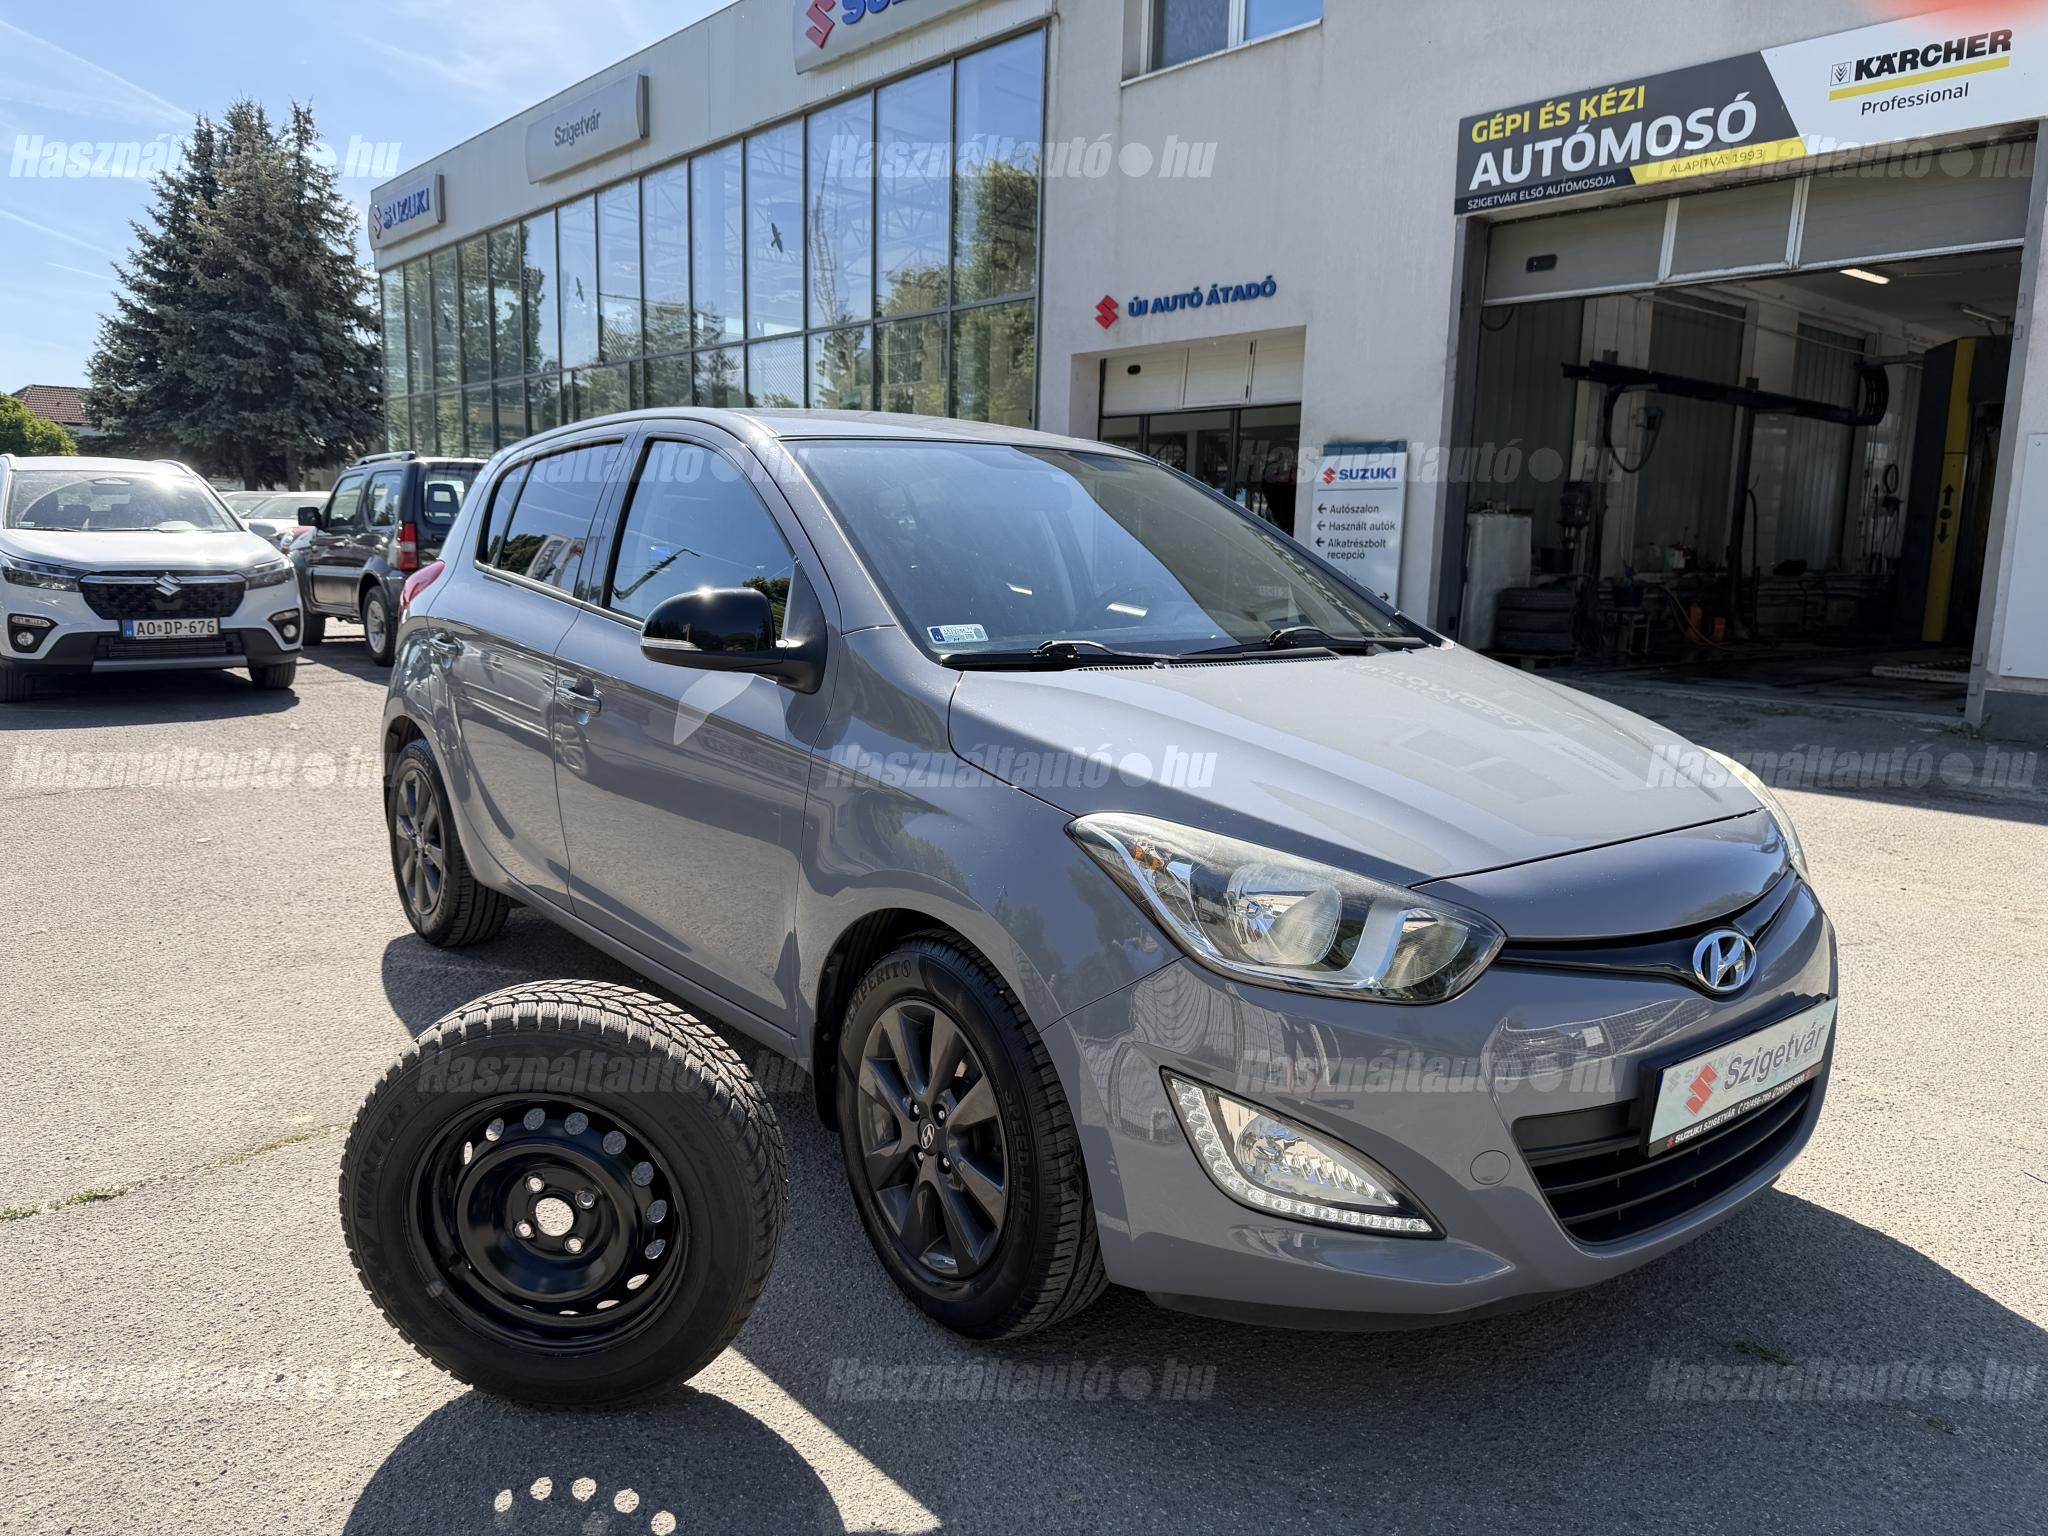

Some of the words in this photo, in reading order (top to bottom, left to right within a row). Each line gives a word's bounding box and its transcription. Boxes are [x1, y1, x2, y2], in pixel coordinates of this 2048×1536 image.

[1854, 29, 2013, 81] KÄRCHER
[1471, 110, 1530, 144] GÉPI
[1538, 101, 1571, 130] ÉS
[1578, 85, 1646, 121] KÉZI
[1861, 82, 1969, 115] Professional
[554, 108, 601, 147] Szigetvár
[1468, 91, 1757, 191] AUTÓMOSÓ
[1732, 149, 1763, 163] 1993
[383, 187, 430, 230] SUZUKI
[1467, 190, 1517, 210] SZIGETVÁR
[1150, 286, 1204, 314] AUTÓ
[1205, 274, 1277, 307] ÁTADÓ
[1338, 467, 1397, 480] SUZUKI
[1328, 520, 1367, 531] Használt
[1369, 519, 1396, 531] autók
[1330, 503, 1380, 514] Autószalon
[1327, 549, 1366, 560] recepció
[1328, 537, 1386, 549] Alkatrészbolt
[842, 961, 901, 1040] SEMPERIT
[1724, 1021, 1825, 1090] Szigetvár
[1675, 1125, 1704, 1144] SUZUKI
[1703, 1108, 1736, 1131] SZIGETVÁR
